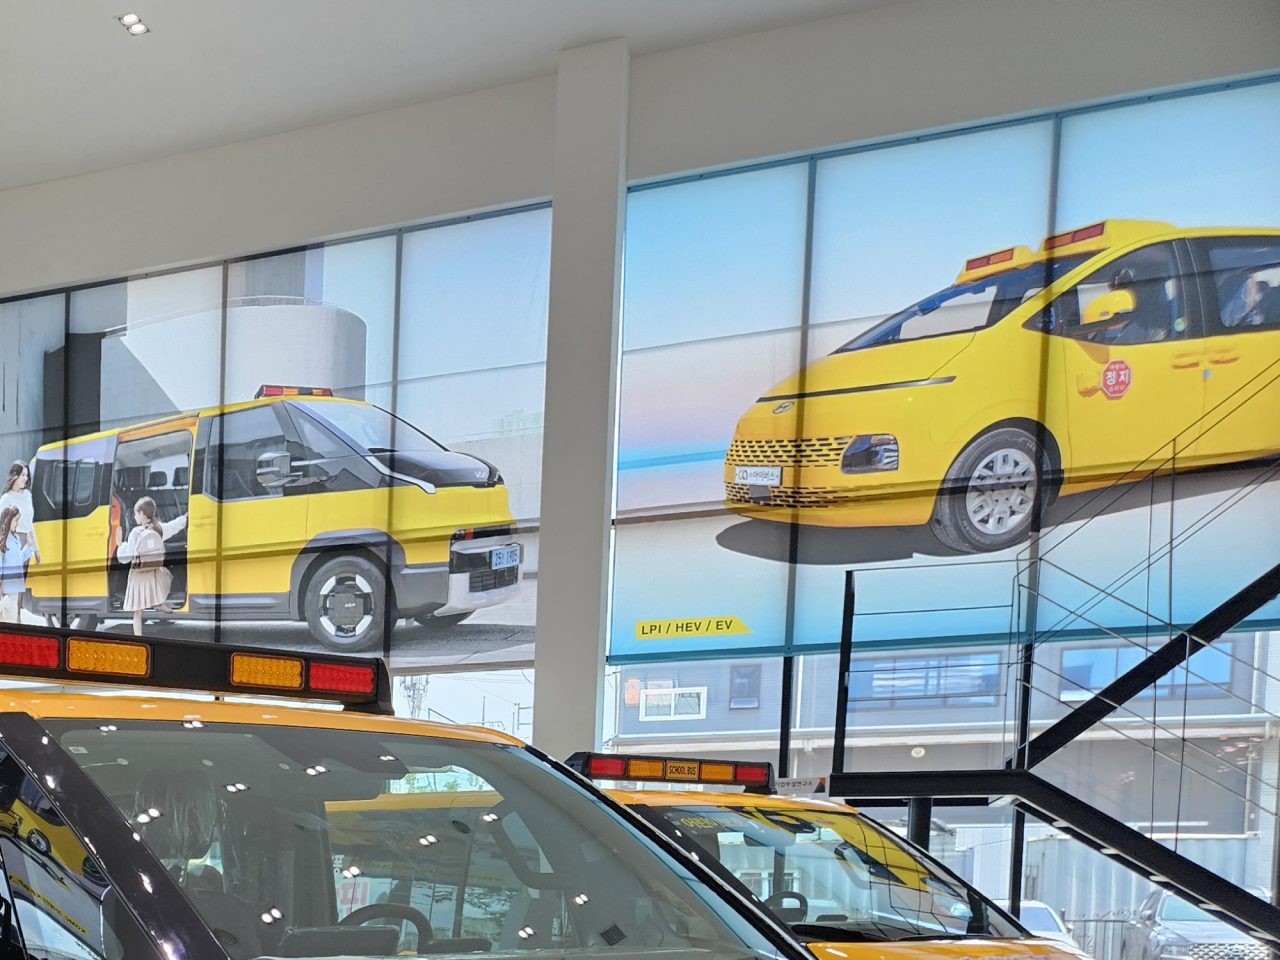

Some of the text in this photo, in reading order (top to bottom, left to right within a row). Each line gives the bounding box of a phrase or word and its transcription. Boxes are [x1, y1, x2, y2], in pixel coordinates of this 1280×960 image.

[641, 624, 662, 636] LPI
[675, 621, 702, 633] HEV
[715, 620, 733, 631] EV
[668, 764, 697, 776] SCHOOL BUS
